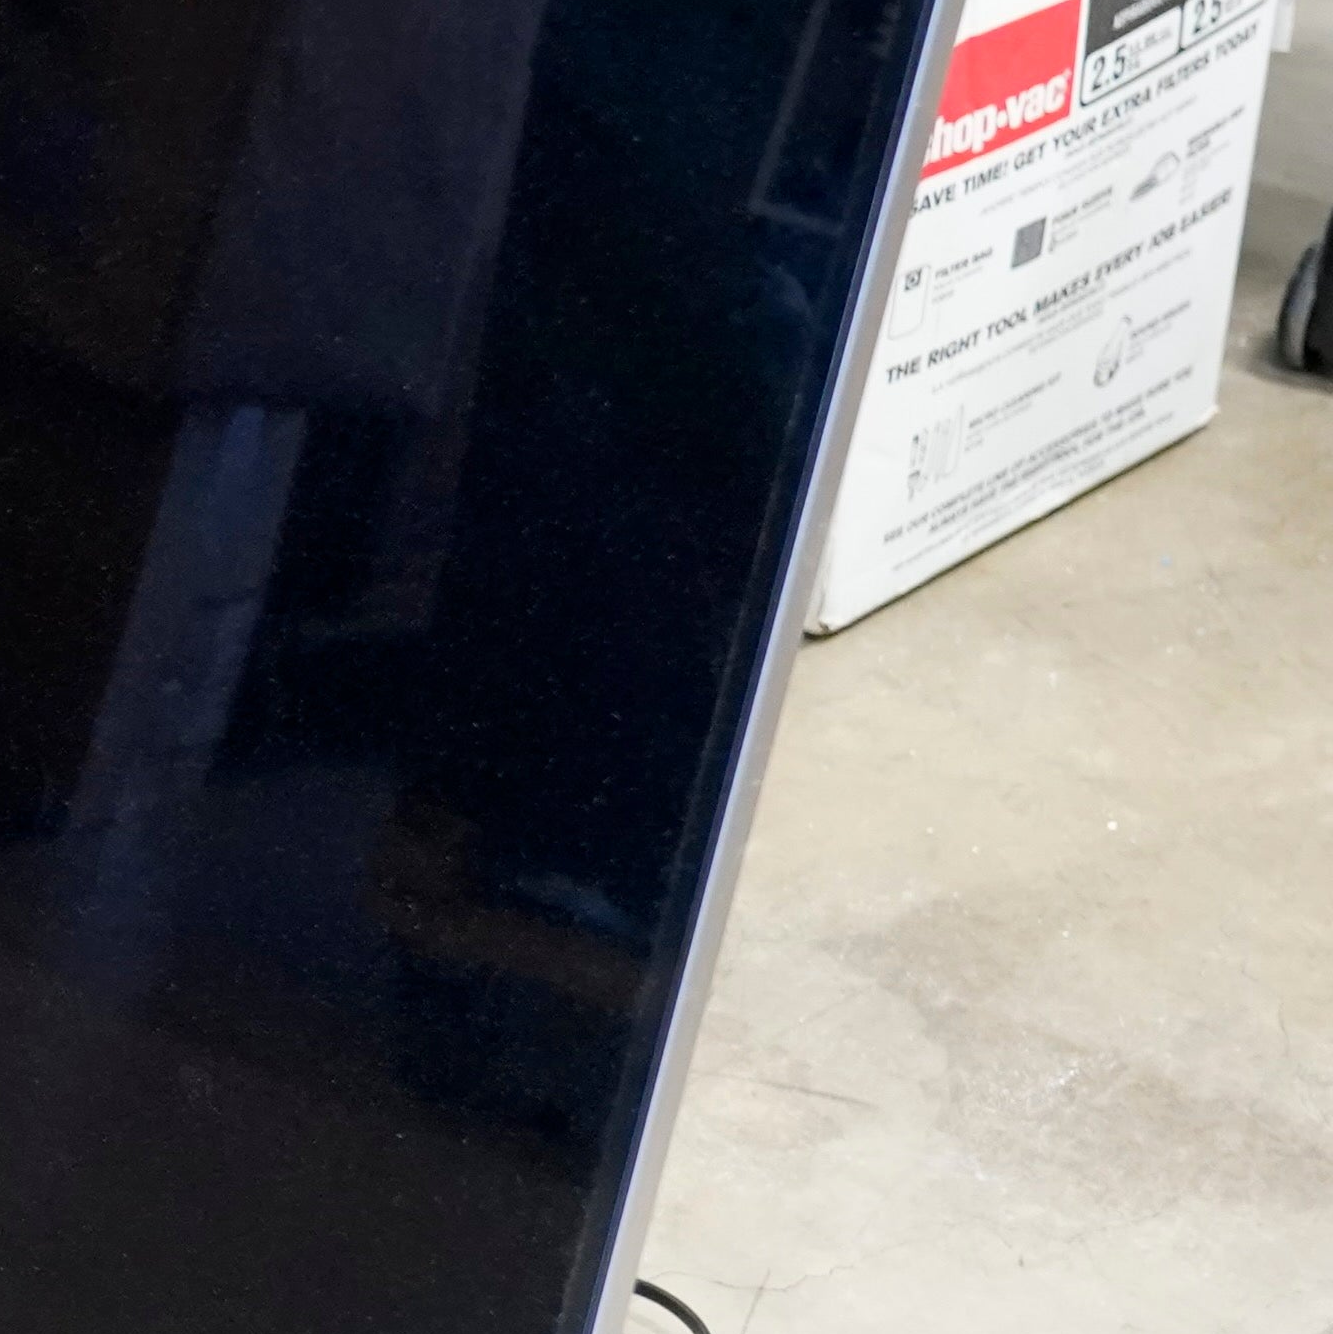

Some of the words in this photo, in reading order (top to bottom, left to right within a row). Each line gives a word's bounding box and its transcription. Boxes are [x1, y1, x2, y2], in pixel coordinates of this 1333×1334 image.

[962, 160, 1009, 195] TIME!
[1013, 142, 1046, 171] GET
[1053, 115, 1097, 150] YOUR
[1101, 87, 1151, 126] EXTRA
[1156, 52, 1210, 96] FILTERS
[1215, 22, 1259, 60] TODAY
[1091, 42, 1126, 92] 2.5
[885, 354, 922, 384] THE
[927, 328, 981, 368] RIGHT
[986, 307, 1028, 339] TOOL
[1033, 271, 1091, 316] MAKES
[1095, 242, 1143, 282] EVERY
[1148, 222, 1177, 252] JOB
[1180, 186, 1233, 234] EASIER
